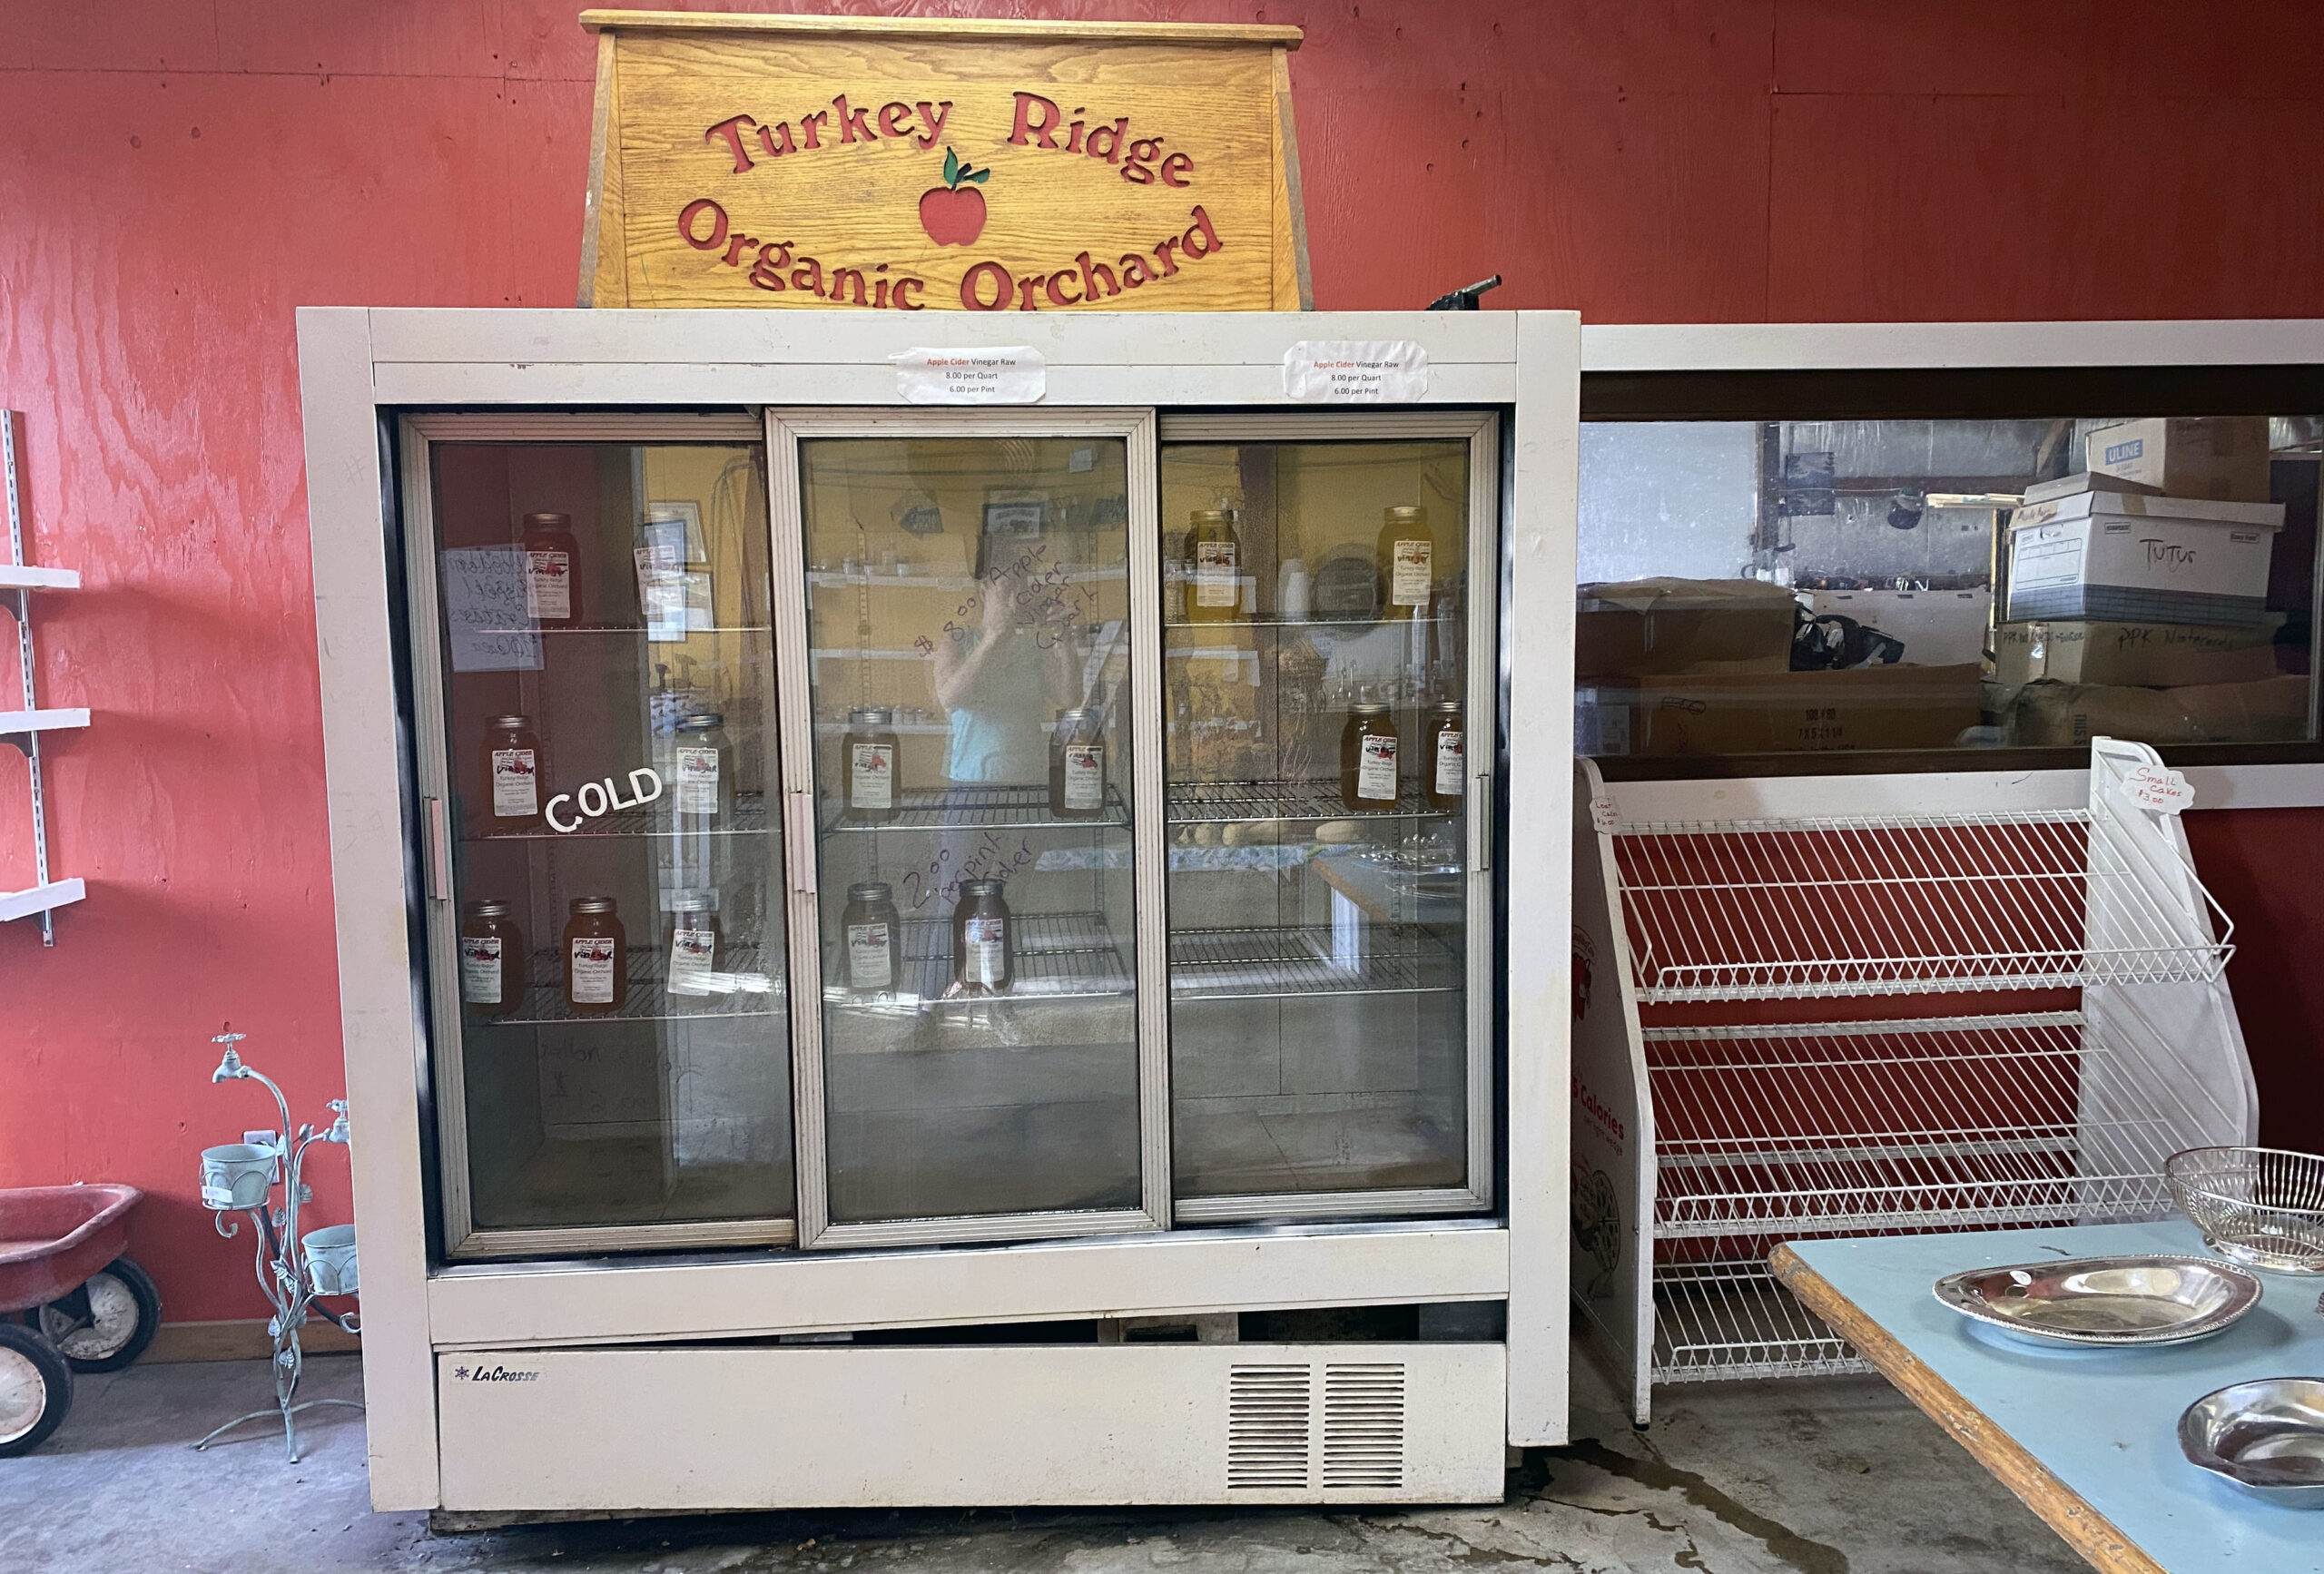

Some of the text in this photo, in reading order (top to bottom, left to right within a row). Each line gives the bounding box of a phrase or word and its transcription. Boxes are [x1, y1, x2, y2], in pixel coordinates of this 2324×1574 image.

[705, 91, 1194, 188] Turkey Ridge
[677, 198, 1224, 311] Organic Orchard
[927, 358, 949, 367] Apple
[950, 358, 970, 366] Cider
[971, 358, 999, 367] Vinegar
[1314, 360, 1334, 369] Apple
[1356, 360, 1382, 369] Vinegar
[1348, 375, 1360, 383] per
[2109, 442, 2140, 462] ULINE
[990, 544, 1047, 586] Apple
[1016, 561, 1063, 607] Cider
[545, 767, 663, 832] COLD
[1581, 1084, 1625, 1141] Calories
